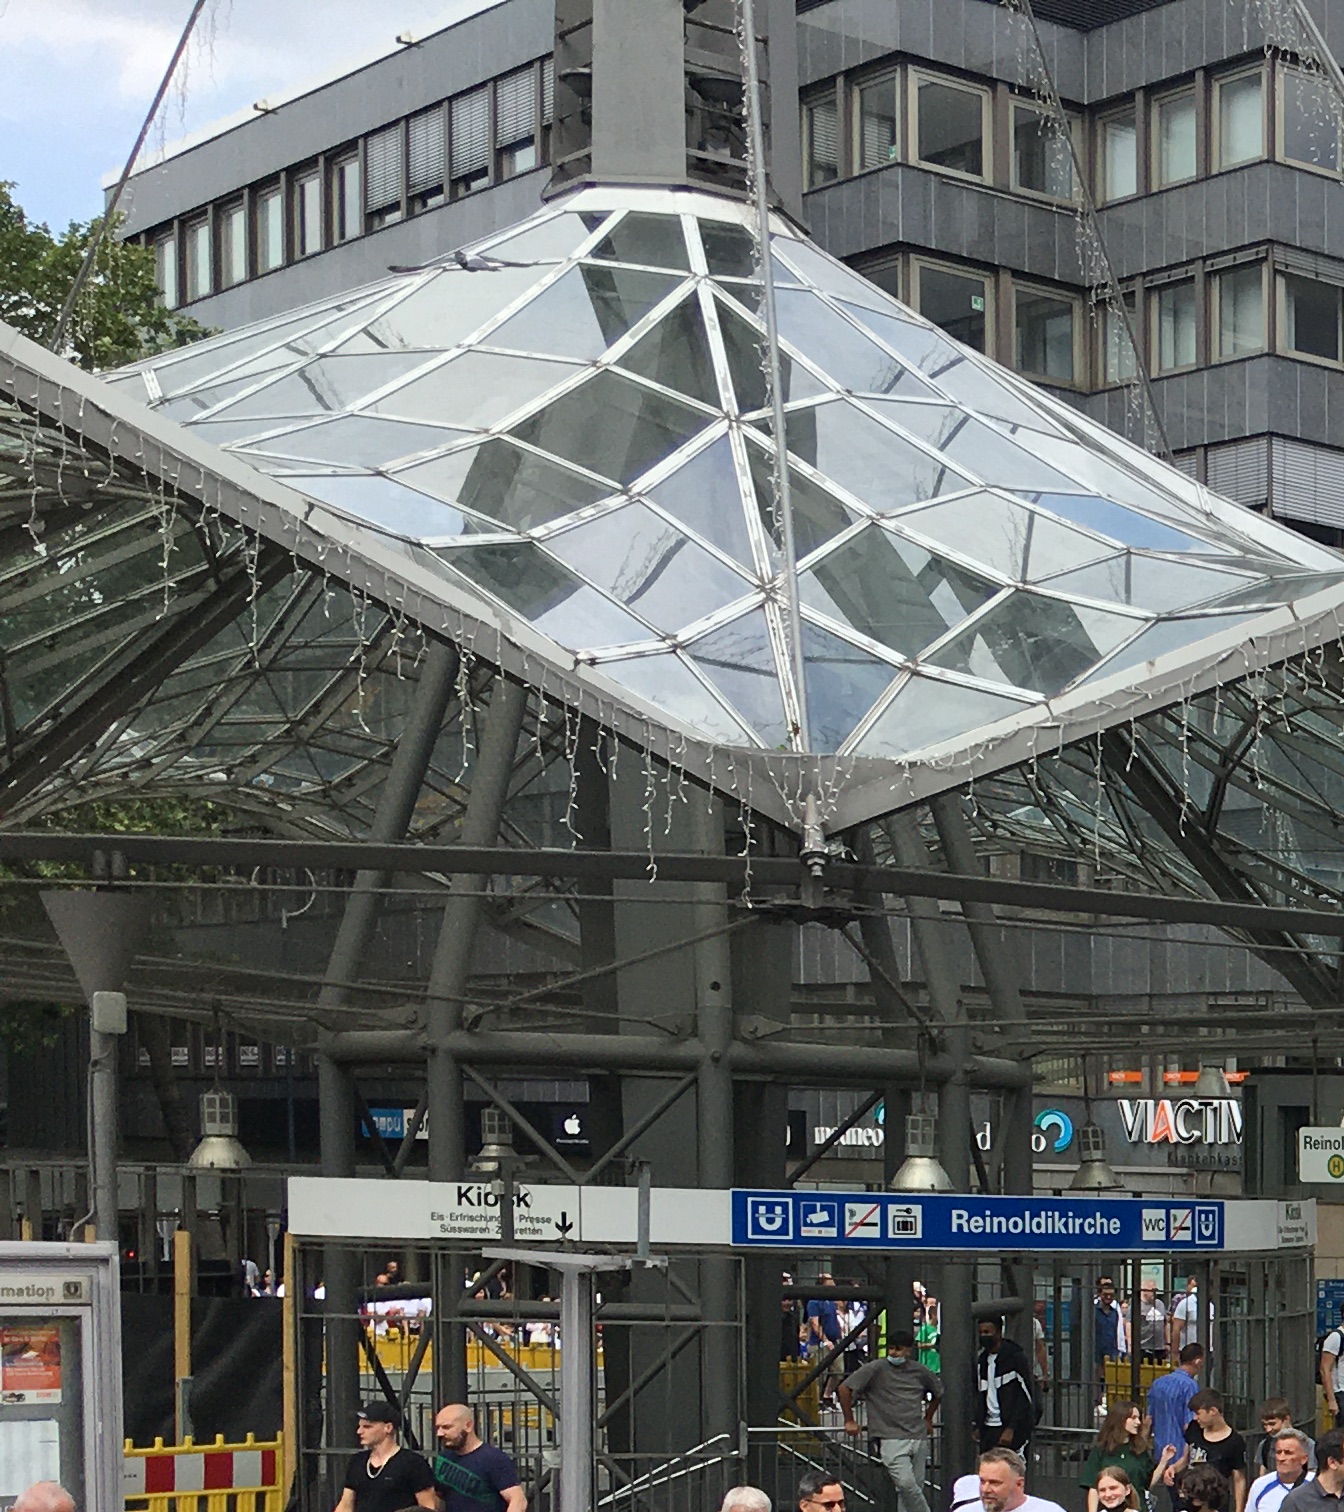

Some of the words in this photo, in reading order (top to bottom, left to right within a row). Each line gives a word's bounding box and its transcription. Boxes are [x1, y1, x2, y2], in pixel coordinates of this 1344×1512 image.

[457, 1186, 531, 1208] Kiok
[449, 1212, 501, 1223] Erfrischung
[519, 1214, 552, 1224] Presse
[951, 1209, 1121, 1235] Reinoldikirche
[1143, 1217, 1166, 1232] WC
[495, 1226, 543, 1236] Zretten
